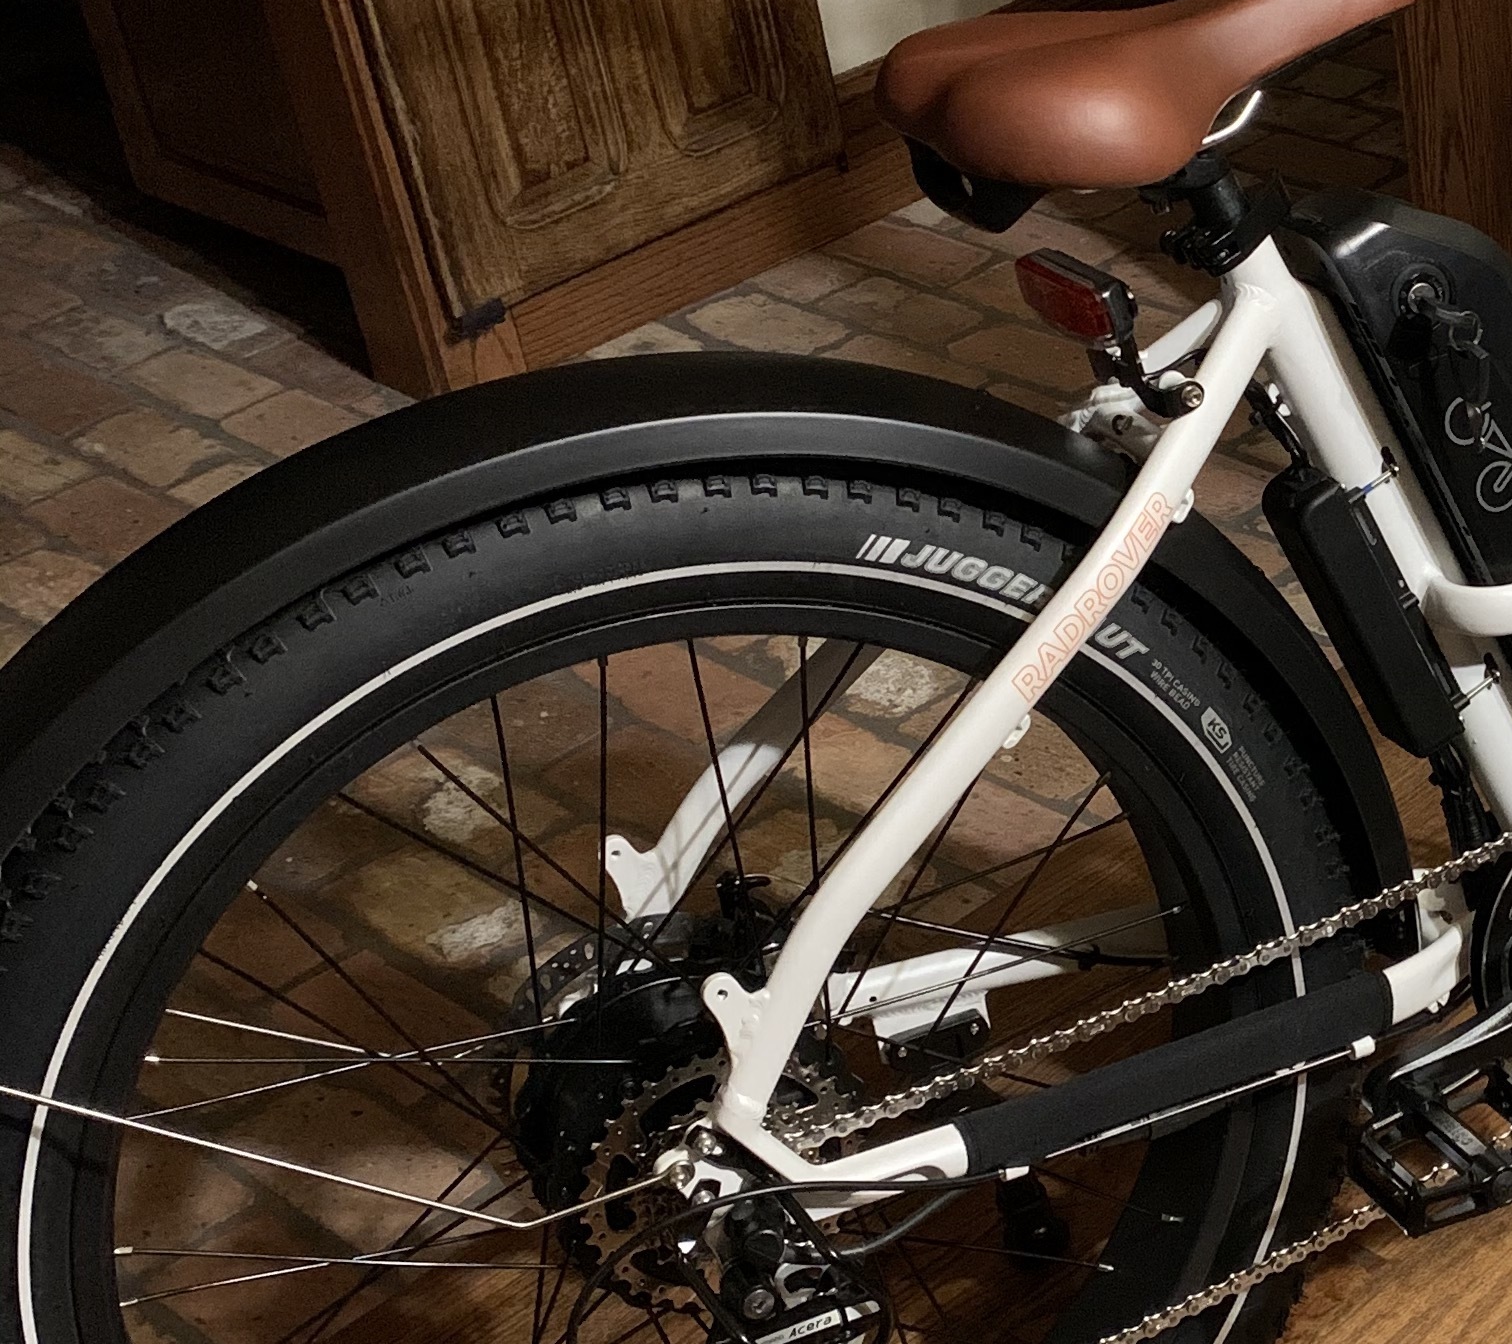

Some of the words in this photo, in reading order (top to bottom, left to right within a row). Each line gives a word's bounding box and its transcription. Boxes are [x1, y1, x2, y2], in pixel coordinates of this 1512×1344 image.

[1011, 492, 1173, 703] RADROVER
[1207, 717, 1227, 739] KS
[788, 1316, 832, 1339] Acera
